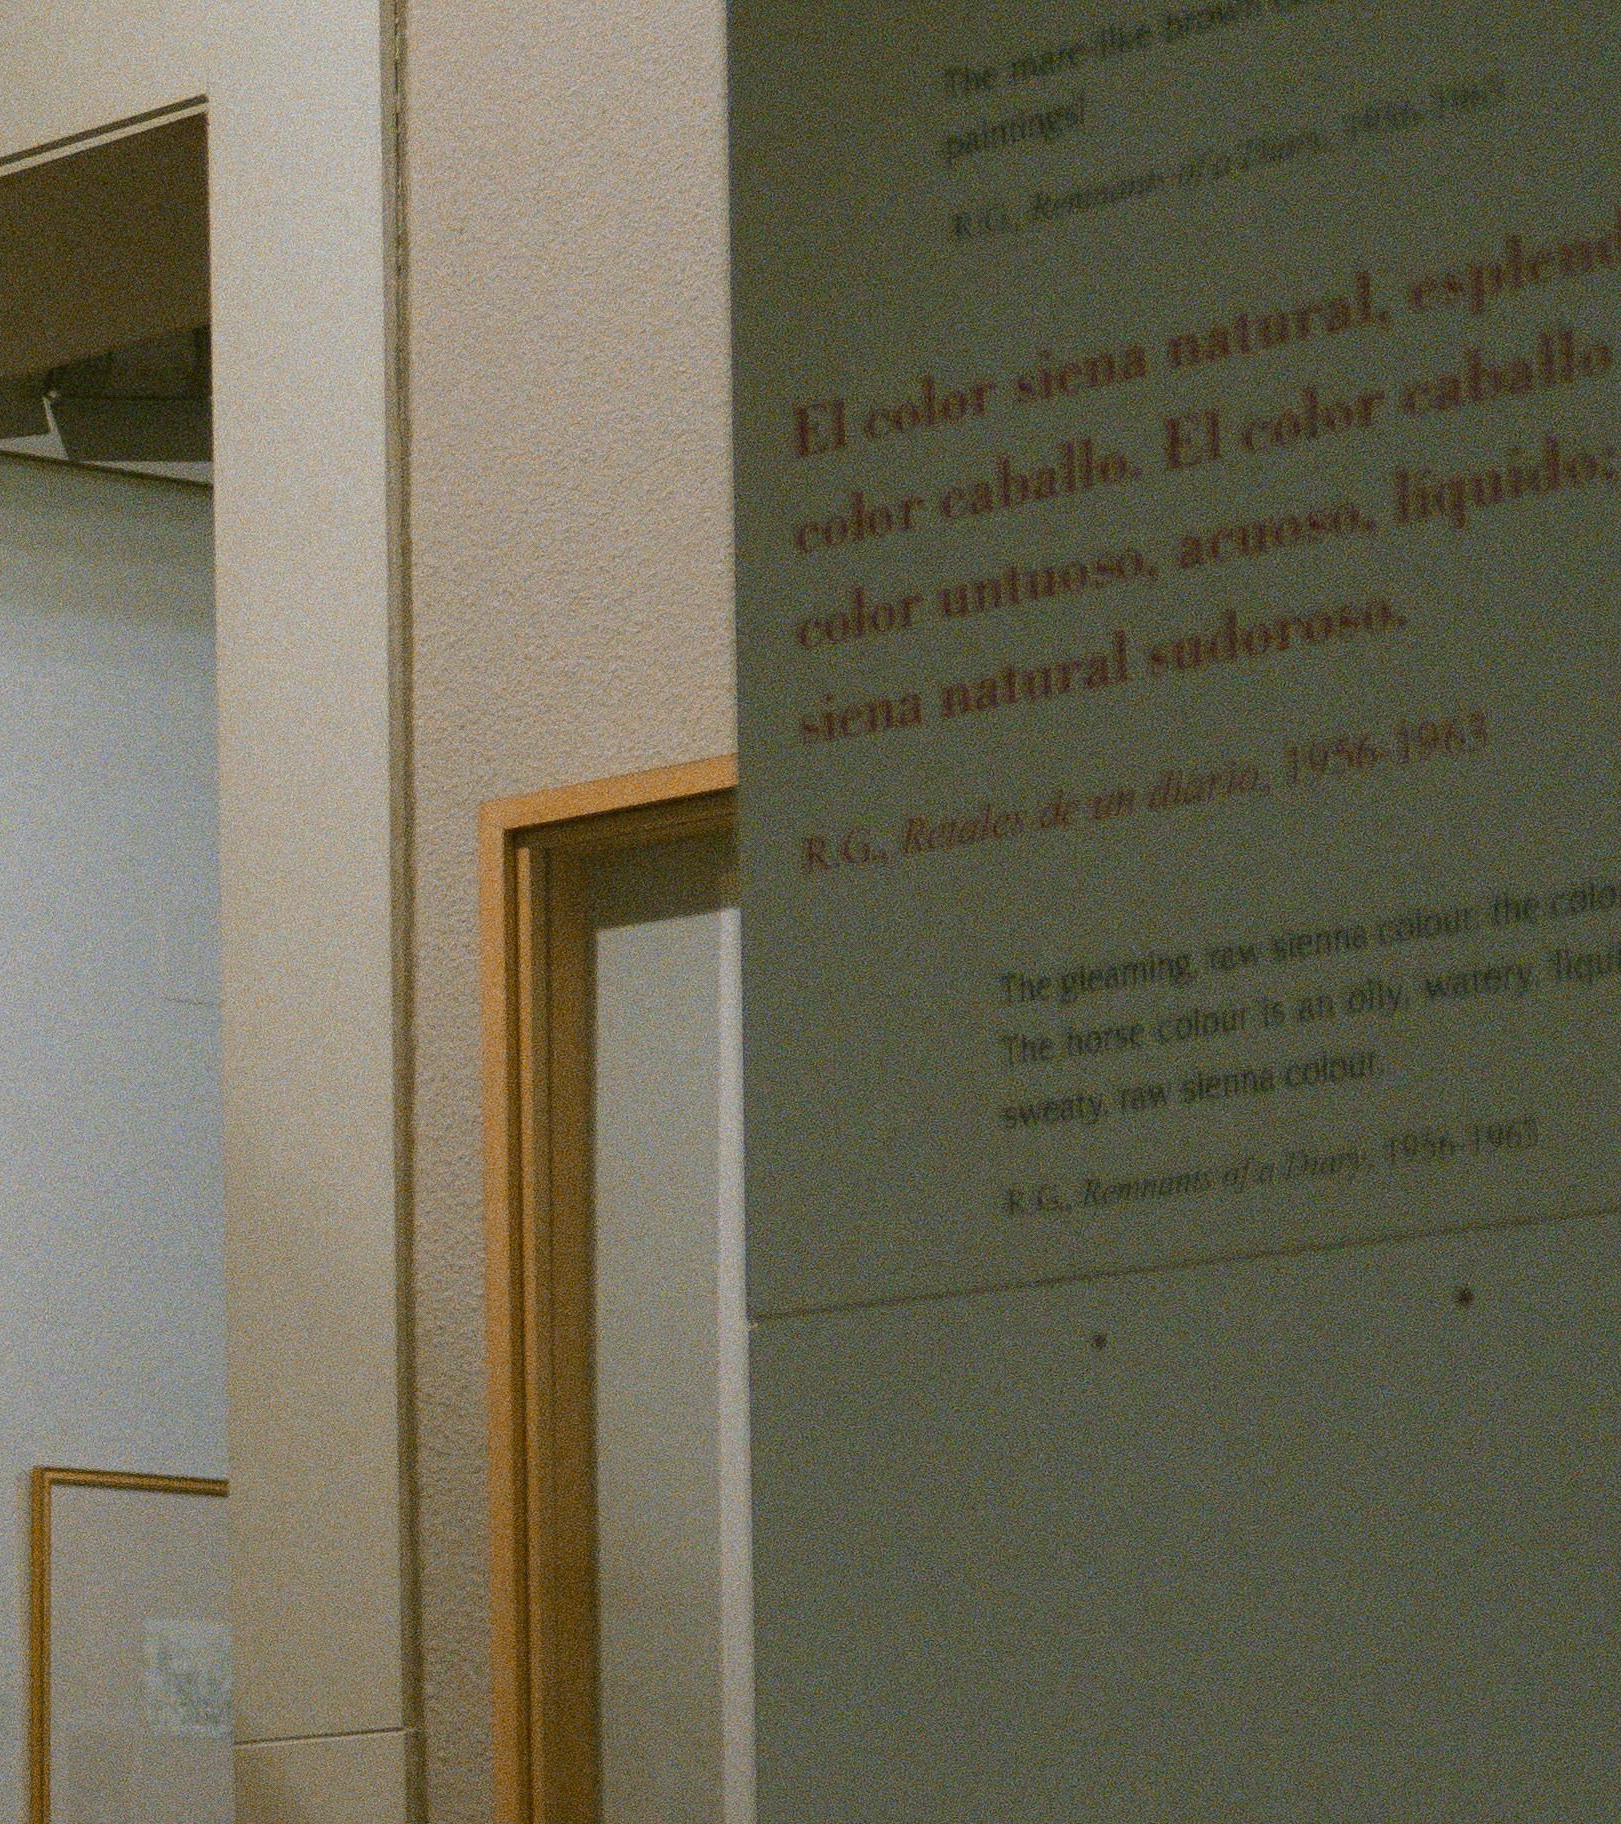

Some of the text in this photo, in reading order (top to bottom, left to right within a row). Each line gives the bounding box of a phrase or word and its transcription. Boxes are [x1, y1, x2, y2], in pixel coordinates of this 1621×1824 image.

[944, 65, 998, 98] The
[793, 400, 847, 457] El
[862, 376, 996, 441] color
[1015, 348, 1147, 404] siena
[1166, 270, 1392, 369] natural,
[793, 491, 923, 554] color
[938, 439, 1141, 521] caballo.
[1163, 410, 1222, 472] El
[1241, 386, 1383, 453] color
[793, 588, 922, 650] color
[938, 543, 1158, 620] untuoso,
[1178, 497, 1376, 568] acuoso,
[800, 598, 1408, 743] siena natural sudoroso.
[1038, 789, 1079, 830] de
[1091, 789, 1136, 822] un
[1001, 972, 1051, 1004] The
[1206, 944, 1259, 973] raw
[1270, 924, 1367, 963] sienna
[1492, 894, 1541, 927] the
[1001, 1033, 1054, 1066] The
[1065, 1022, 1146, 1058] horse
[1157, 1007, 1247, 1047] colour
[1260, 999, 1285, 1029] is
[1296, 993, 1335, 1022] an
[1117, 1082, 1169, 1113] raw
[1179, 1067, 1277, 1105] sienna
